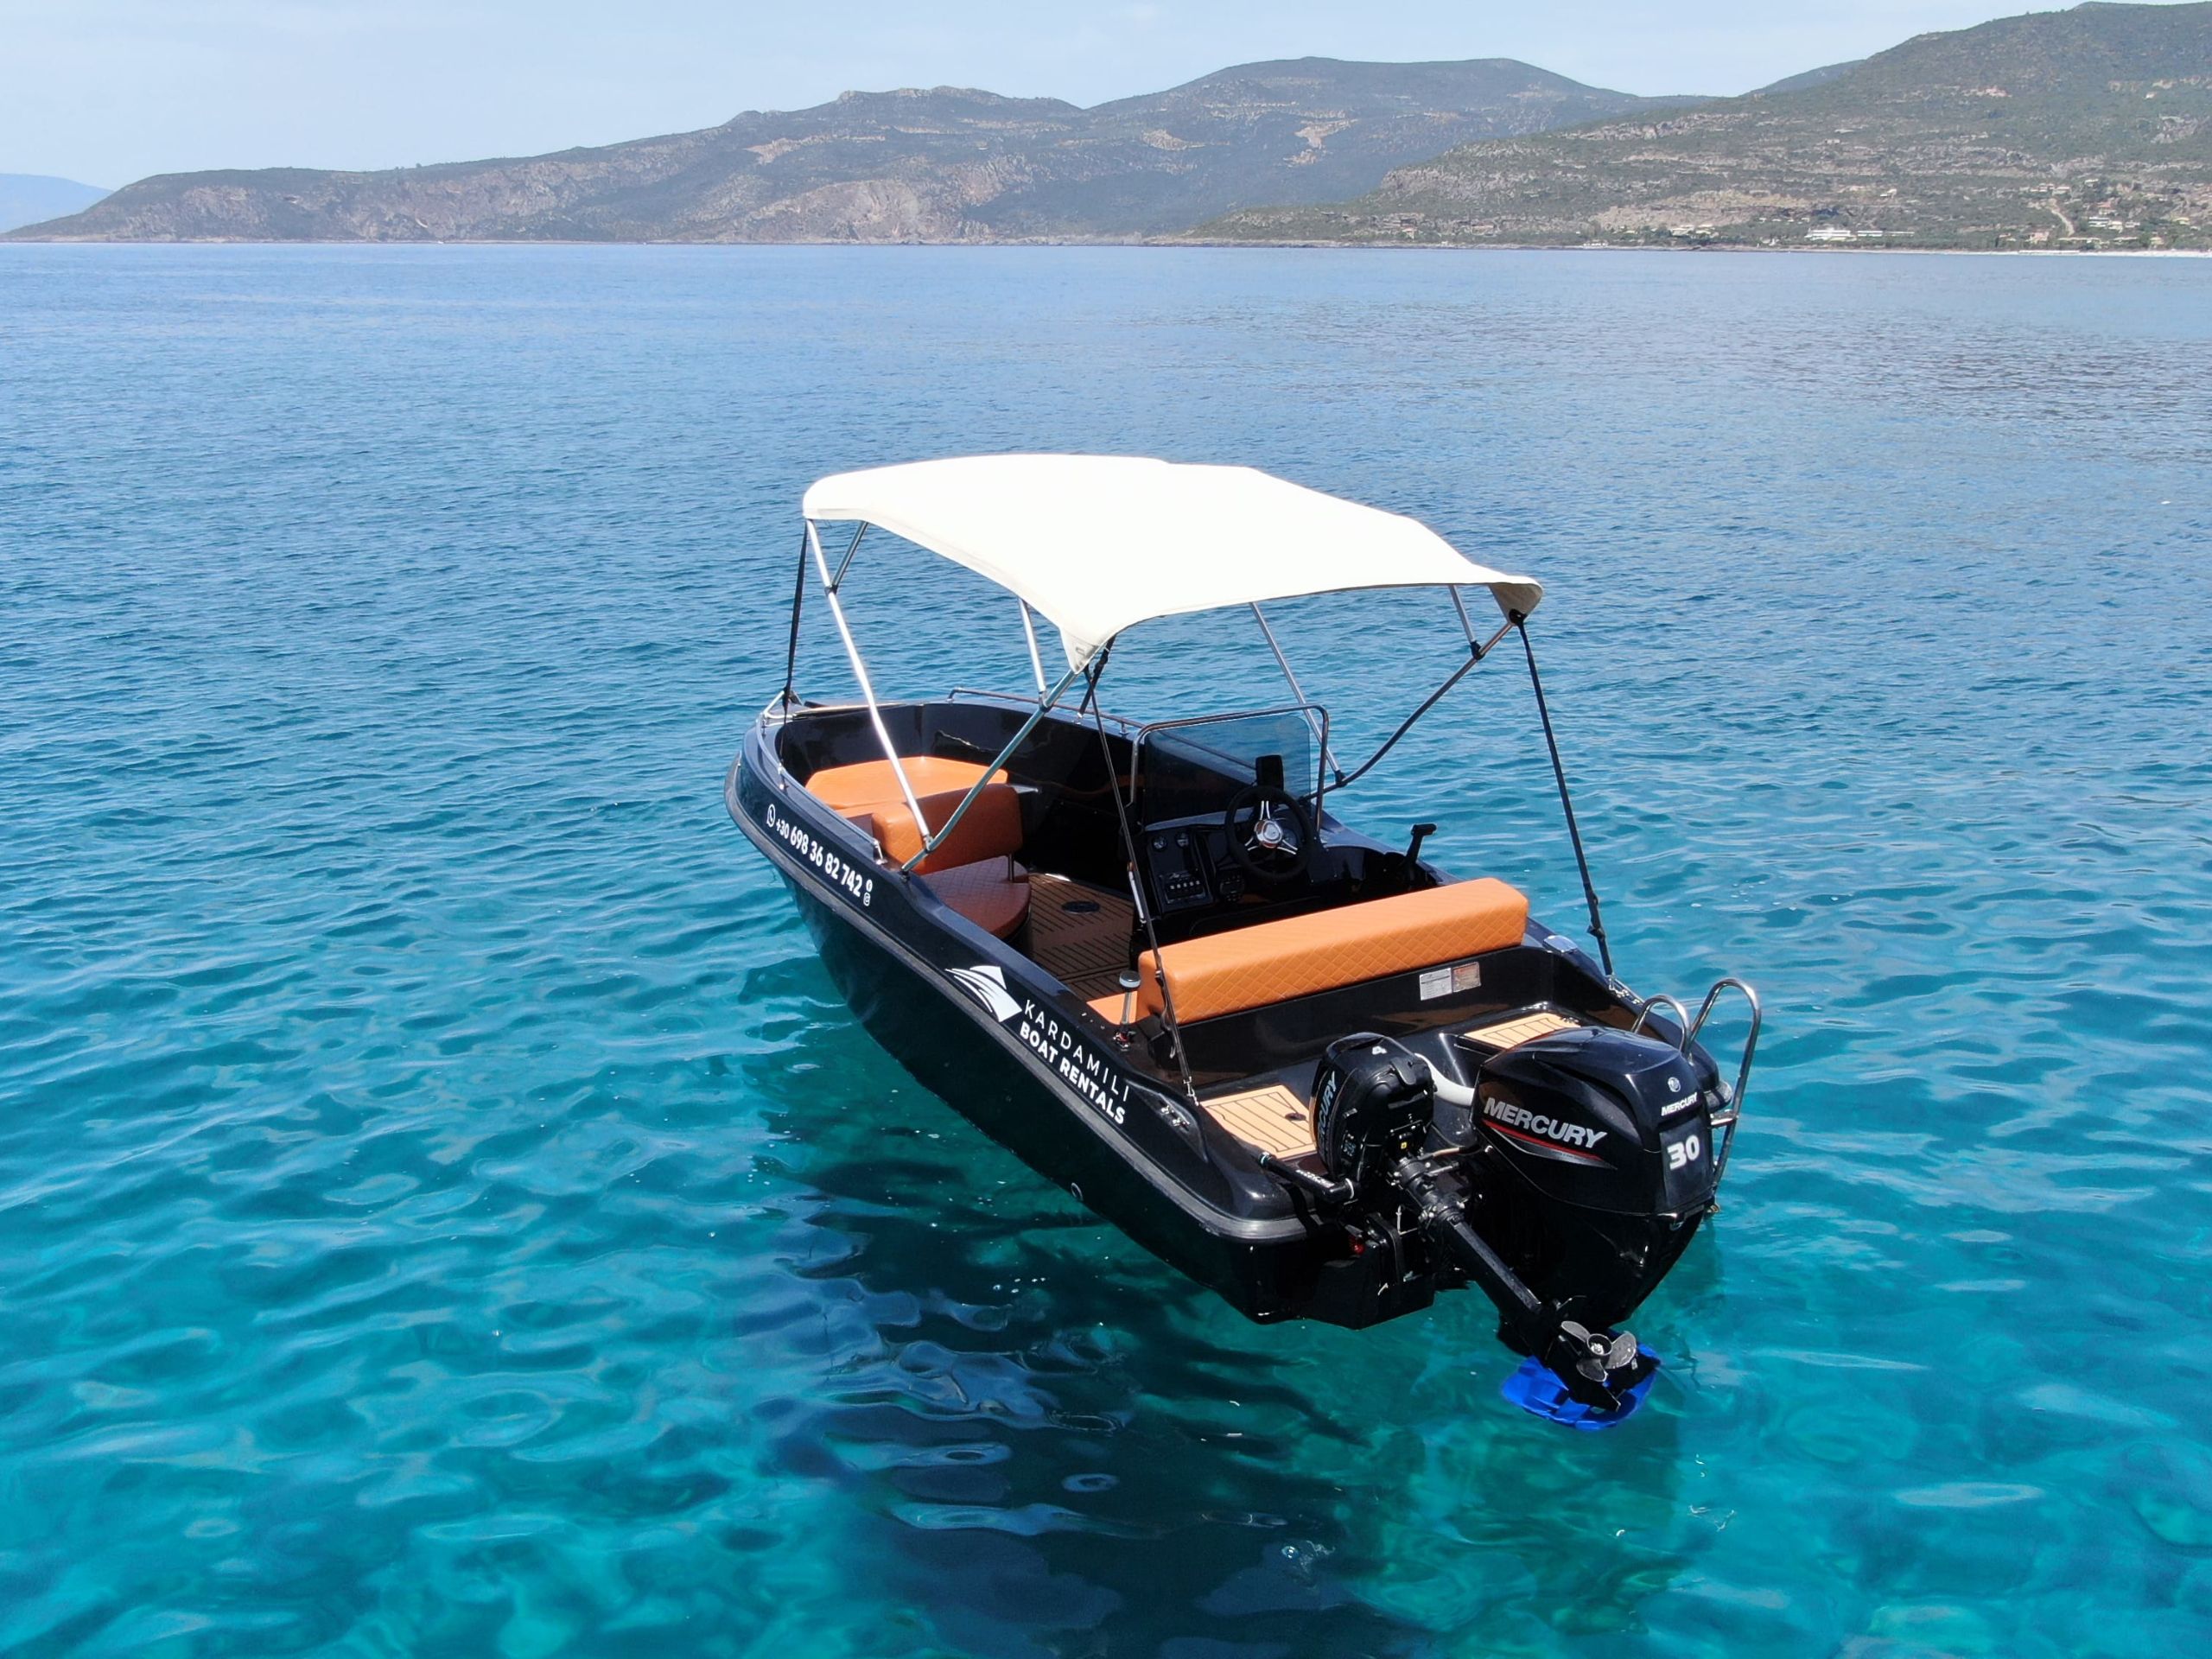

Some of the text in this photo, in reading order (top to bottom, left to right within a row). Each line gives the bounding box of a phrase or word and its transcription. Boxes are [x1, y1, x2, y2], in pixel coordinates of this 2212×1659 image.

[775, 818, 862, 898] +30 698 36 82 742
[1020, 1020, 1125, 1124] BOAT RENTALS
[1025, 1000, 1129, 1102] KARDAMILI
[1318, 1071, 1337, 1153] RCURY
[1484, 1096, 1607, 1148] MERCURY
[1661, 1091, 1698, 1116] MERCURY
[1667, 1135, 1700, 1171] 30
